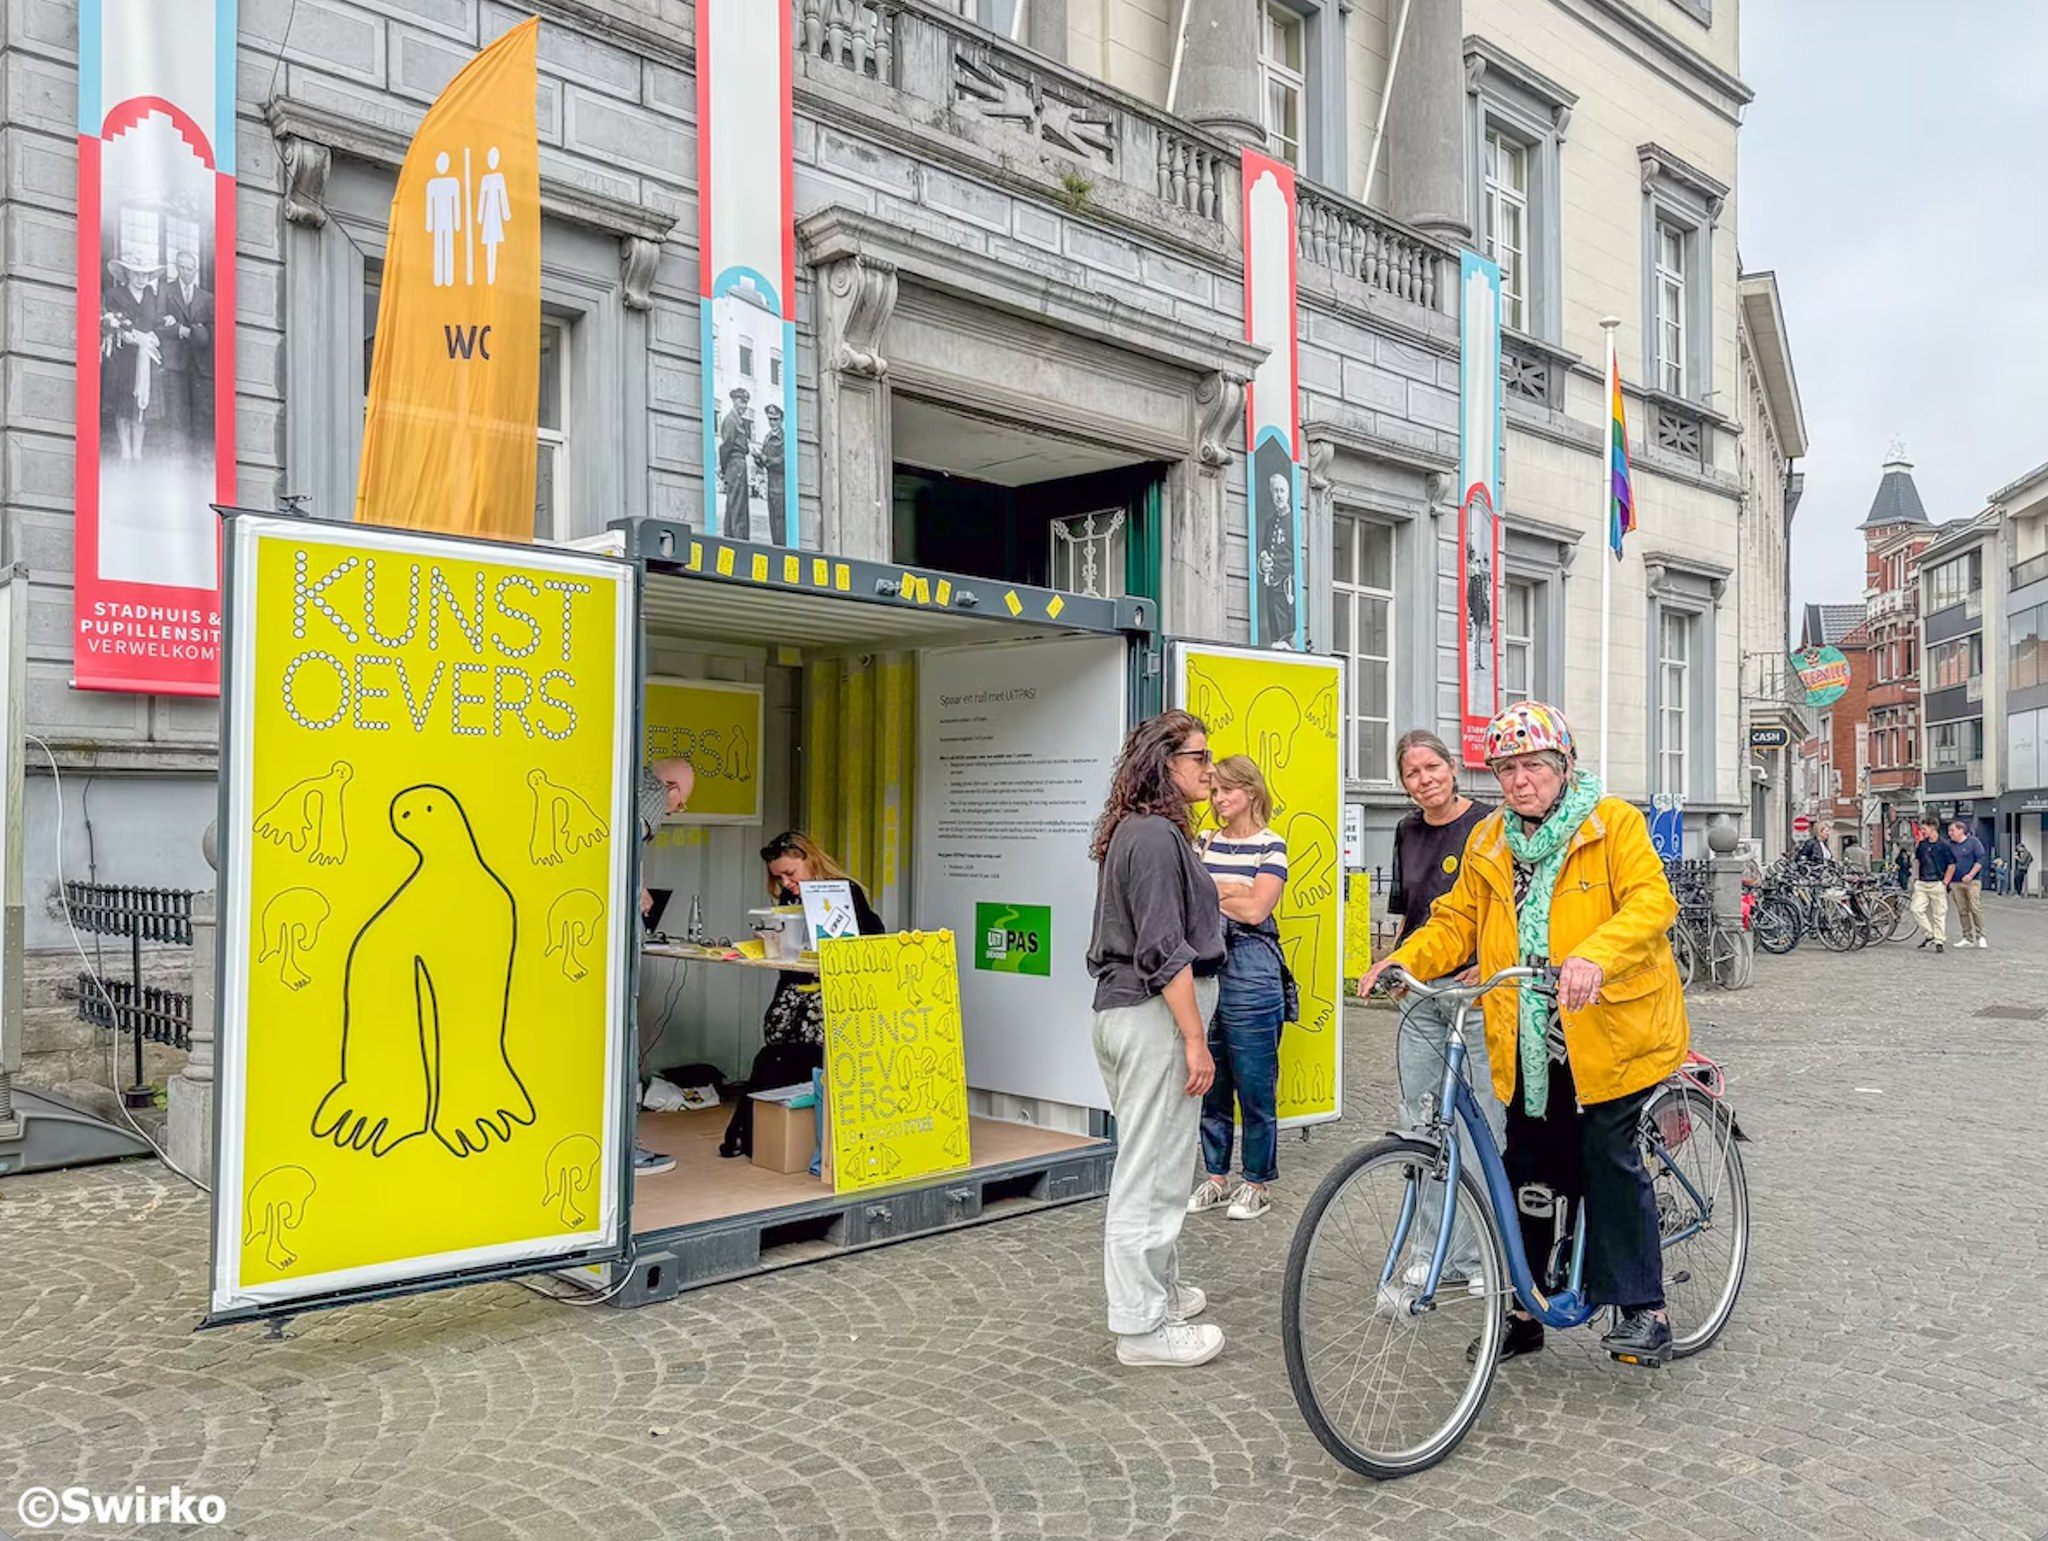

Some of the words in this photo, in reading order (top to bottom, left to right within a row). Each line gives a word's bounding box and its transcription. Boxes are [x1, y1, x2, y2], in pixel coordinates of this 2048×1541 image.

[444, 325, 491, 360] WC
[94, 601, 202, 624] STADHUIS
[208, 611, 222, 626] &
[294, 549, 591, 662] KUNST
[87, 638, 221, 661] VERWELKOM
[281, 650, 577, 741] OEVERS
[1751, 732, 1780, 742] CASH
[831, 1006, 934, 1051] KUNST
[834, 1048, 896, 1090] OEV
[839, 1084, 898, 1126] ERS
